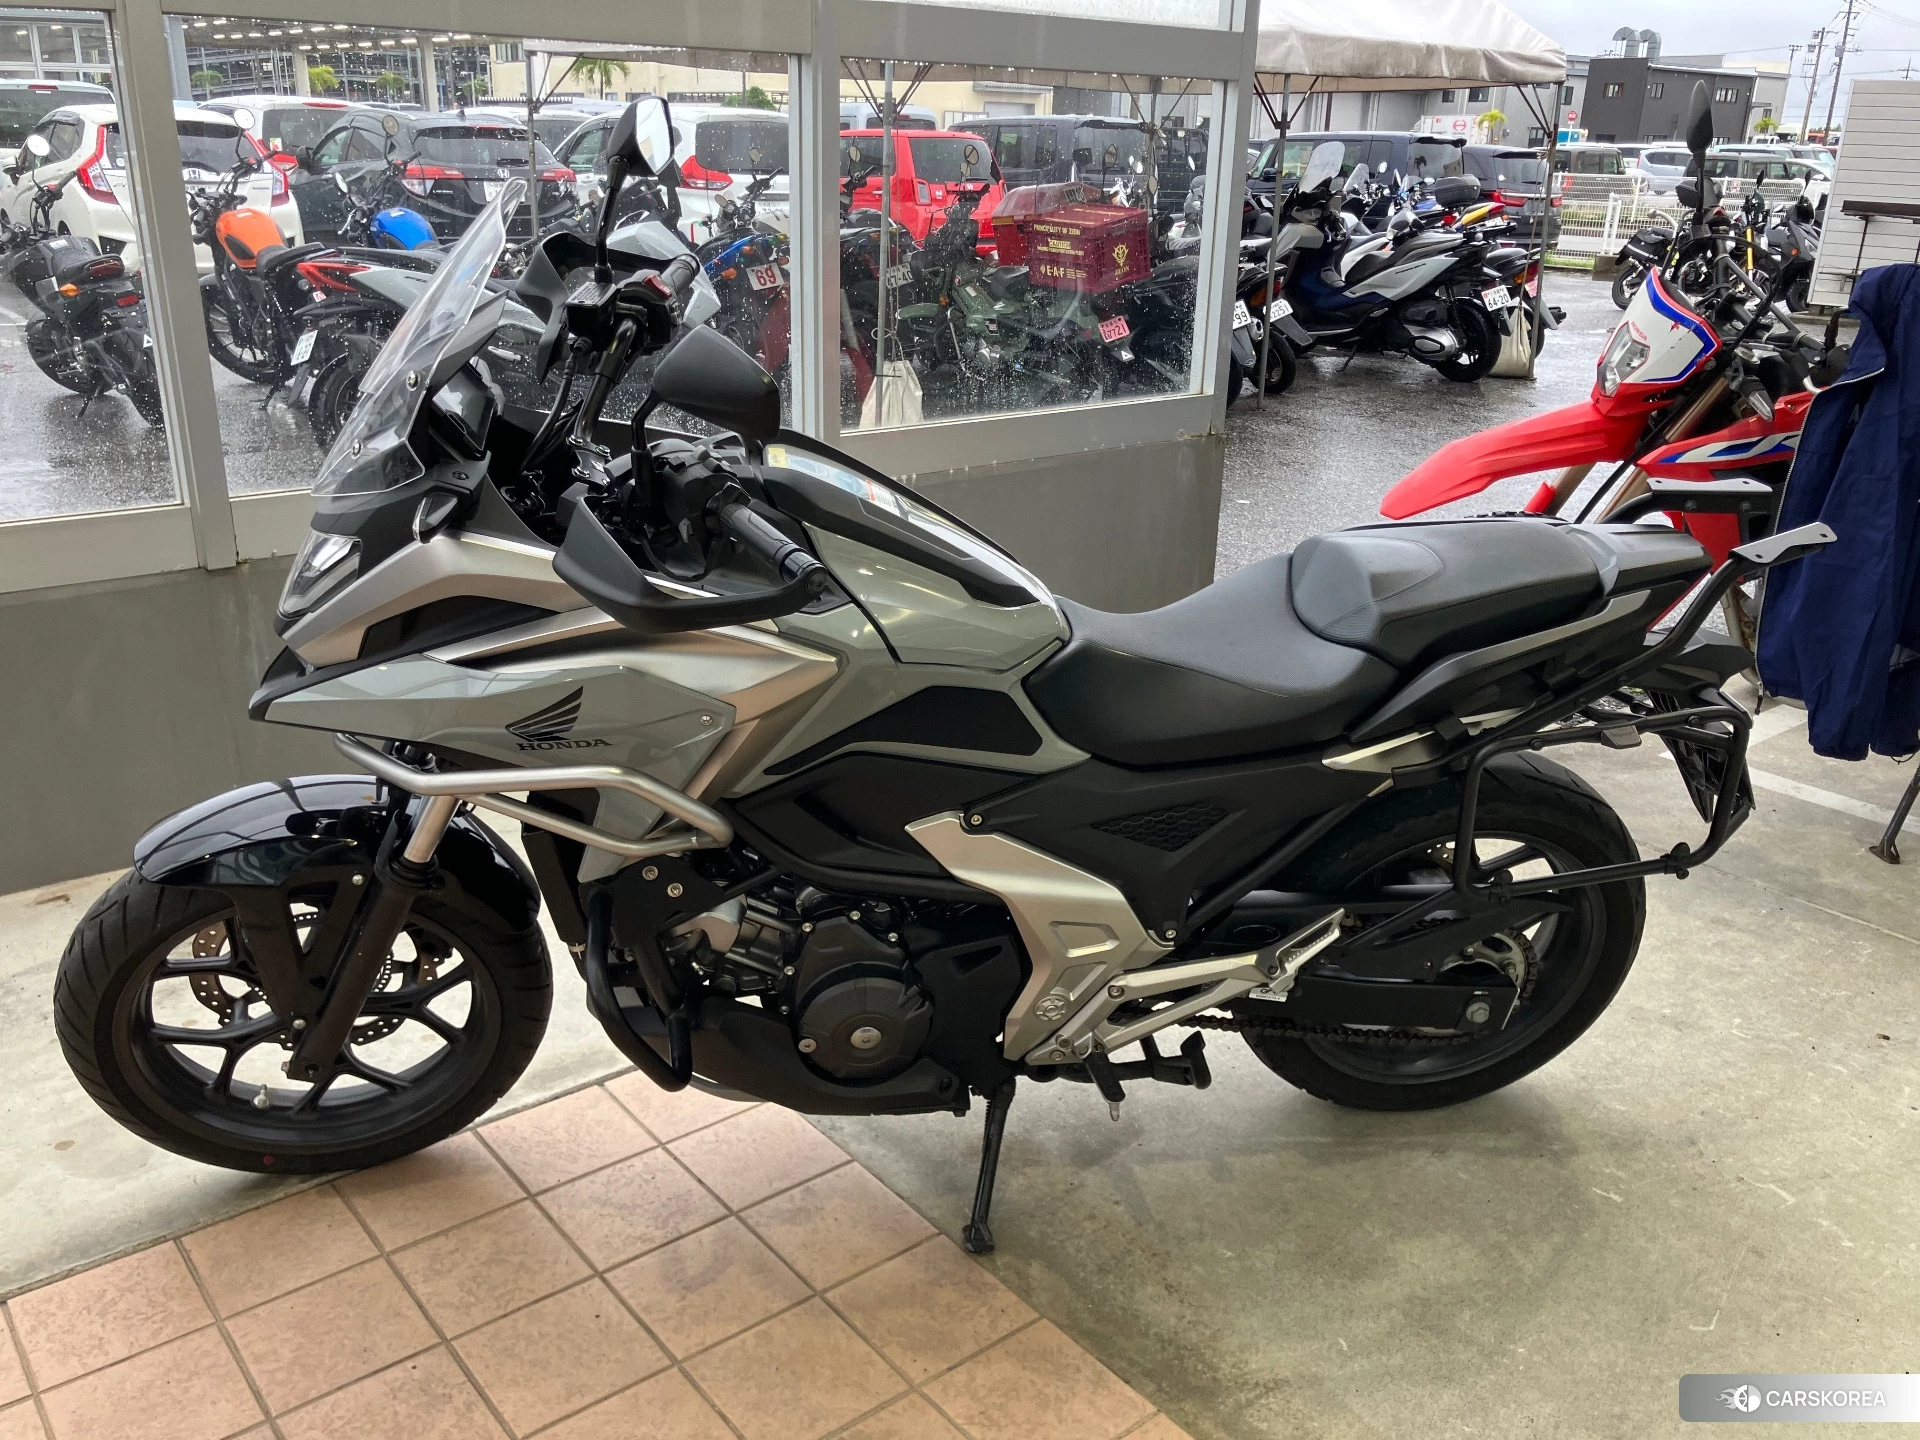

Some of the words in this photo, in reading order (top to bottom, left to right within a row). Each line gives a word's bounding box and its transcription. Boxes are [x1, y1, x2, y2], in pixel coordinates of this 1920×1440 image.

[1033, 223, 1061, 234] PRINCIPALITY
[755, 265, 777, 287] 69
[1488, 293, 1509, 309] 64-20
[1631, 320, 1647, 341] HONDA
[515, 738, 613, 751] HONDA
